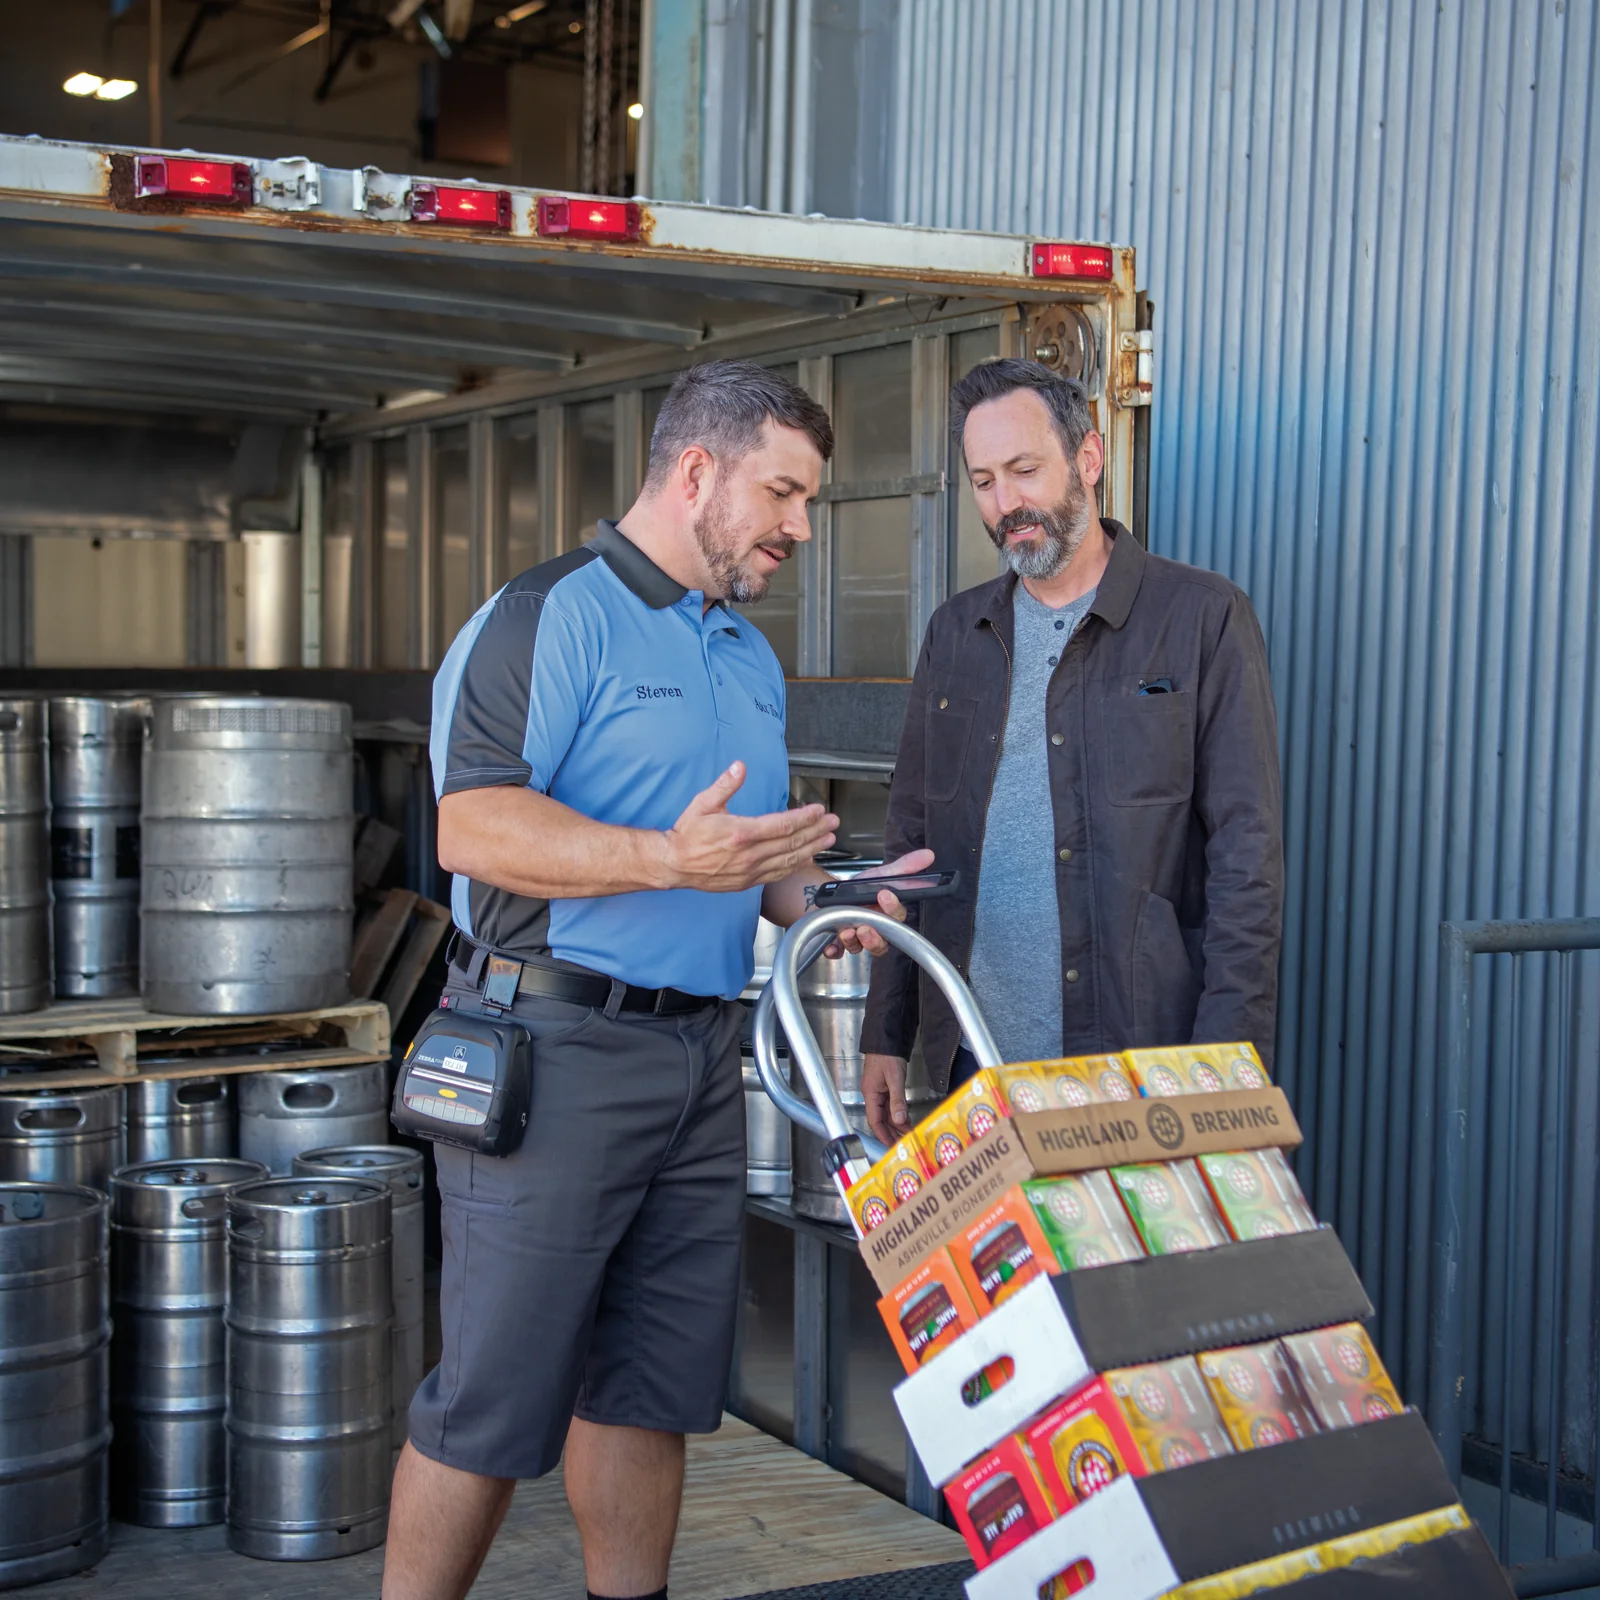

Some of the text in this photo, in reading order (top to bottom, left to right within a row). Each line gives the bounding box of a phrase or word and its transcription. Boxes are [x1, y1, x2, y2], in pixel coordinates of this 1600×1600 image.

[636, 685, 684, 700] Steven
[418, 1055, 435, 1063] ZEBRA
[971, 1077, 984, 1097] 6
[1037, 1106, 1280, 1152] HIGHLAND BREWING
[897, 1143, 908, 1162] 6
[871, 1196, 940, 1262] HIGHLAND
[940, 1135, 1010, 1202] BREWING
[898, 1218, 950, 1269] ASHEVILLE
[952, 1172, 1005, 1222] PIONEERS
